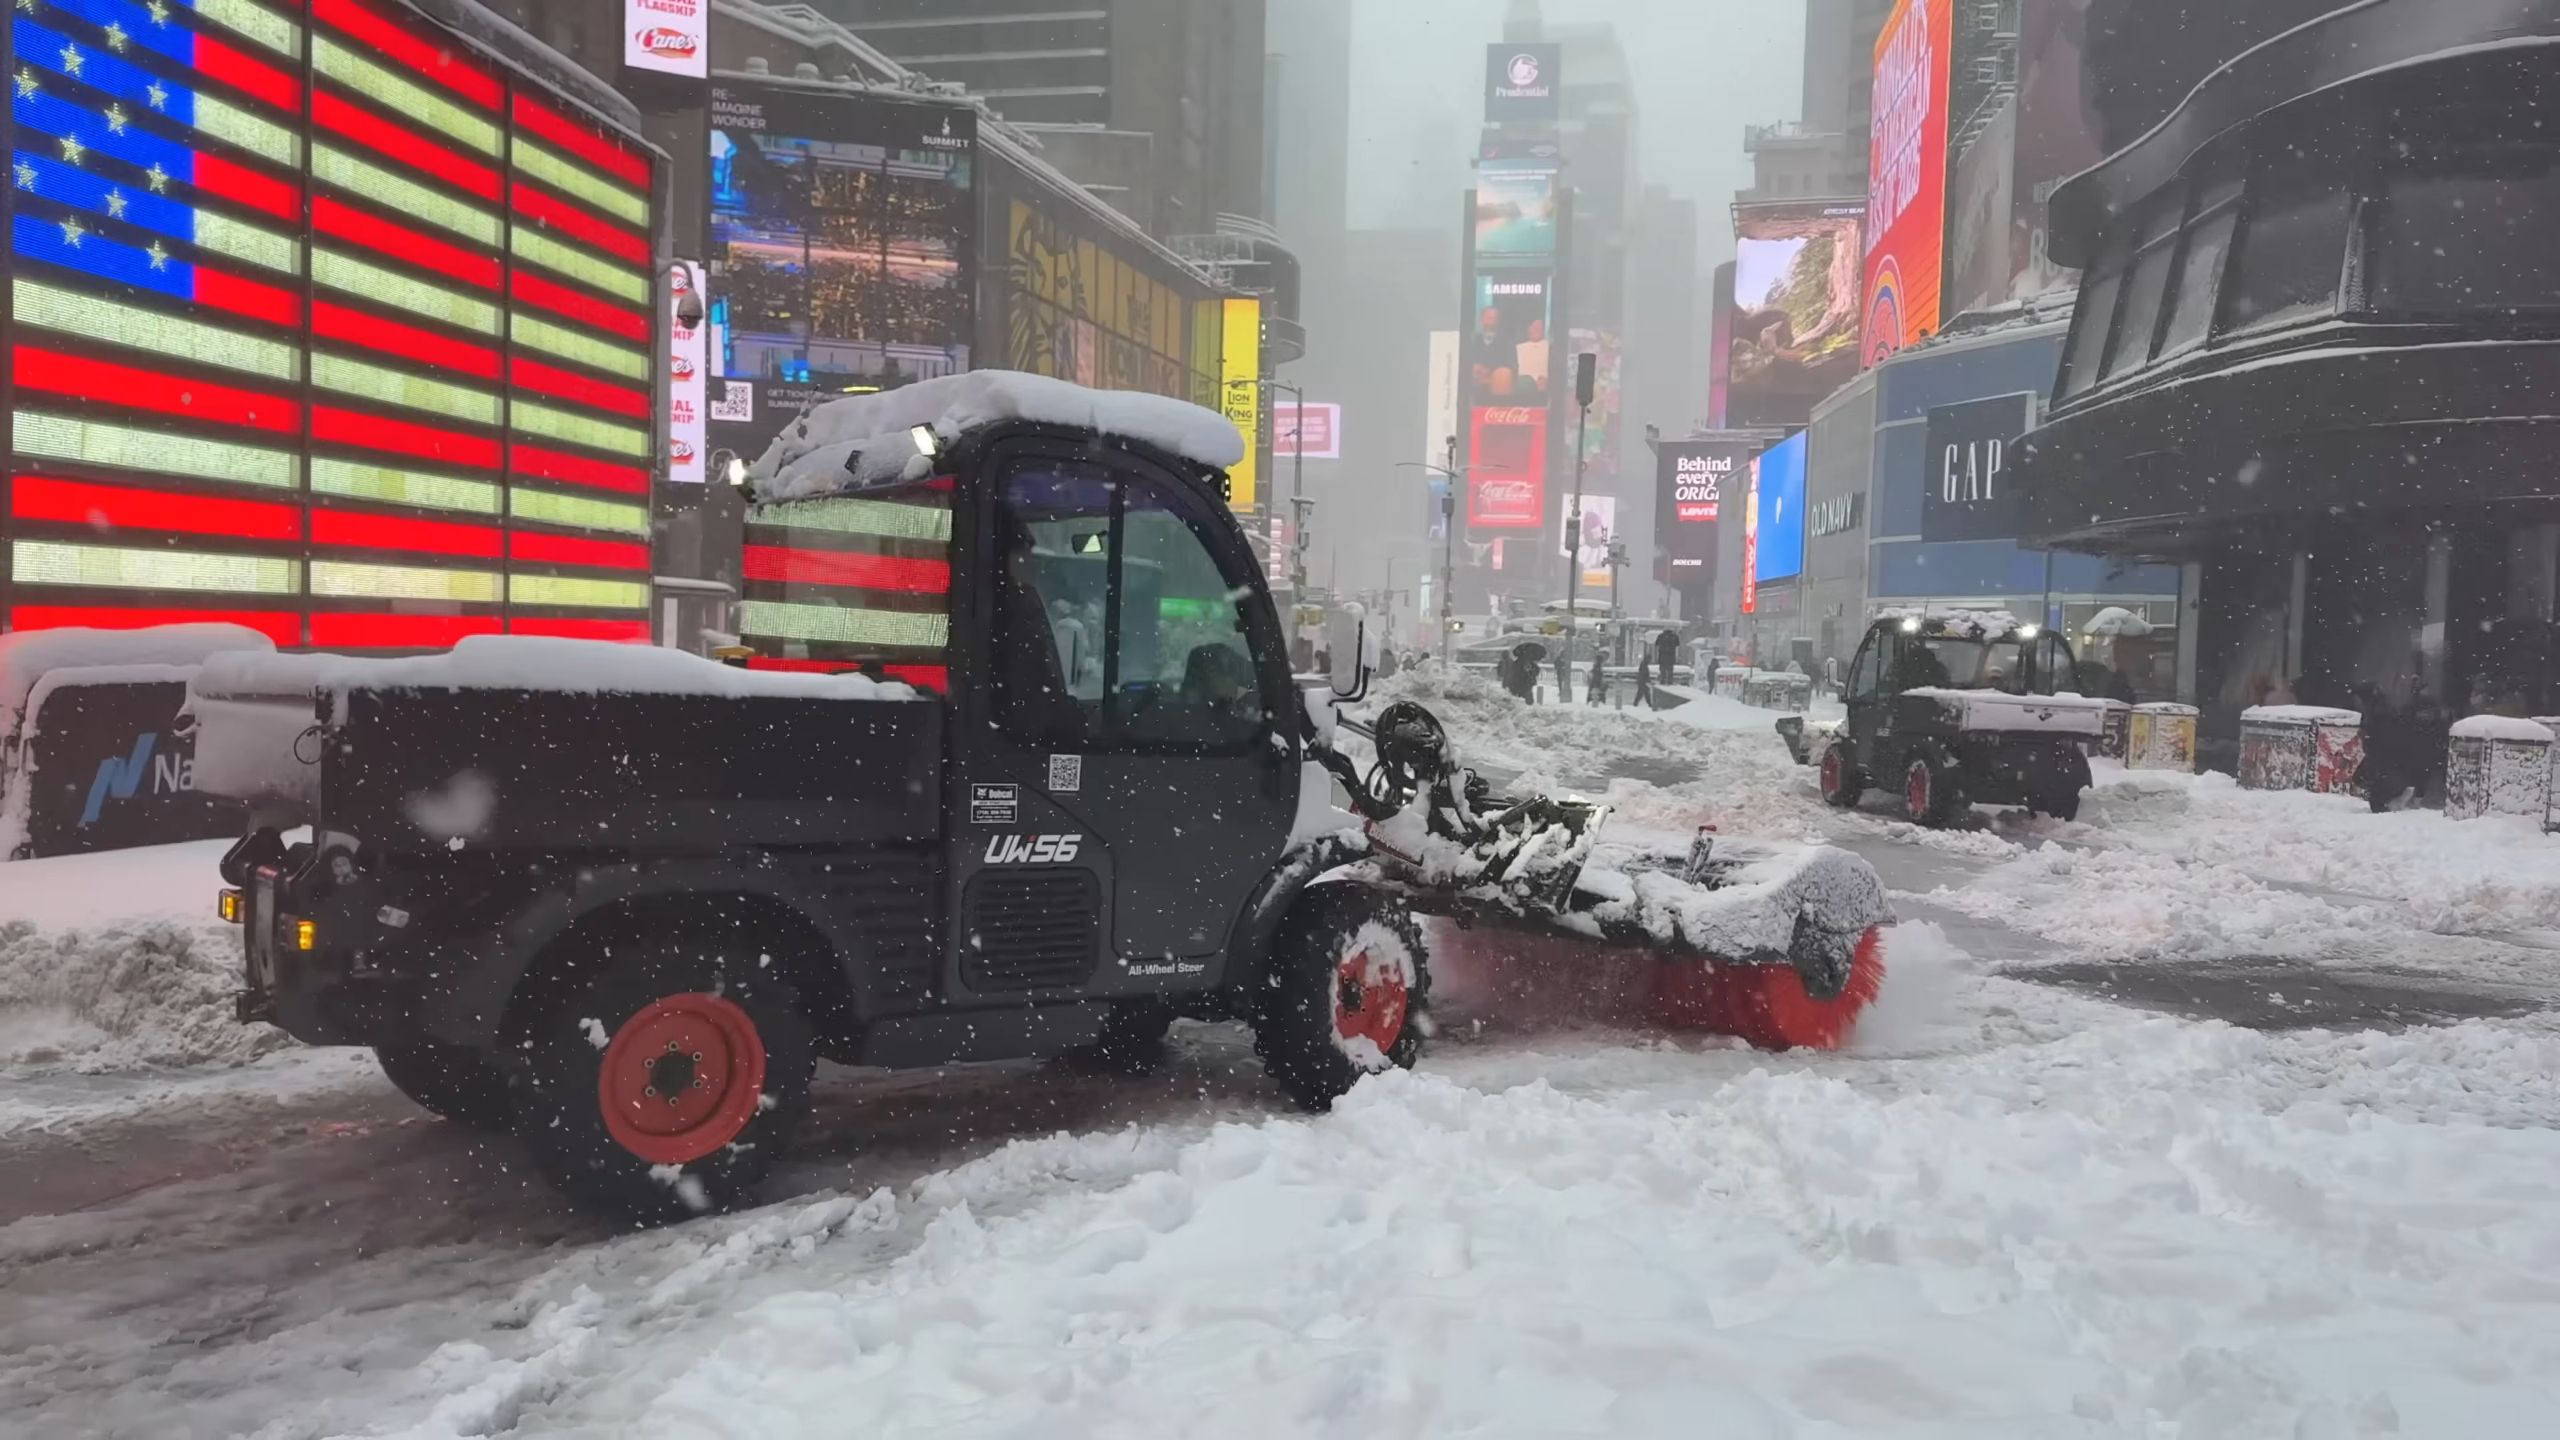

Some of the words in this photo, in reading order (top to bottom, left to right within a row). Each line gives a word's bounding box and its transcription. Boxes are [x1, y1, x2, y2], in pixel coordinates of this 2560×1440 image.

[1495, 86, 1549, 97] Prudential
[712, 101, 763, 117] IMAGINE
[1882, 47, 1932, 178] AMERICAN
[711, 113, 767, 129] WONDER
[921, 135, 969, 148] SUMMIT
[1484, 283, 1543, 295] SAMSUNG
[1227, 390, 1250, 405] LION
[1225, 406, 1253, 422] KING
[1677, 456, 1732, 471] Behind
[1943, 439, 2002, 503] GAP
[1675, 472, 1718, 489] every
[1811, 501, 1828, 537] OLD
[1828, 491, 1853, 532] NAVY
[1128, 963, 1175, 976] All-Wheel
[1178, 962, 1205, 973] Steer
